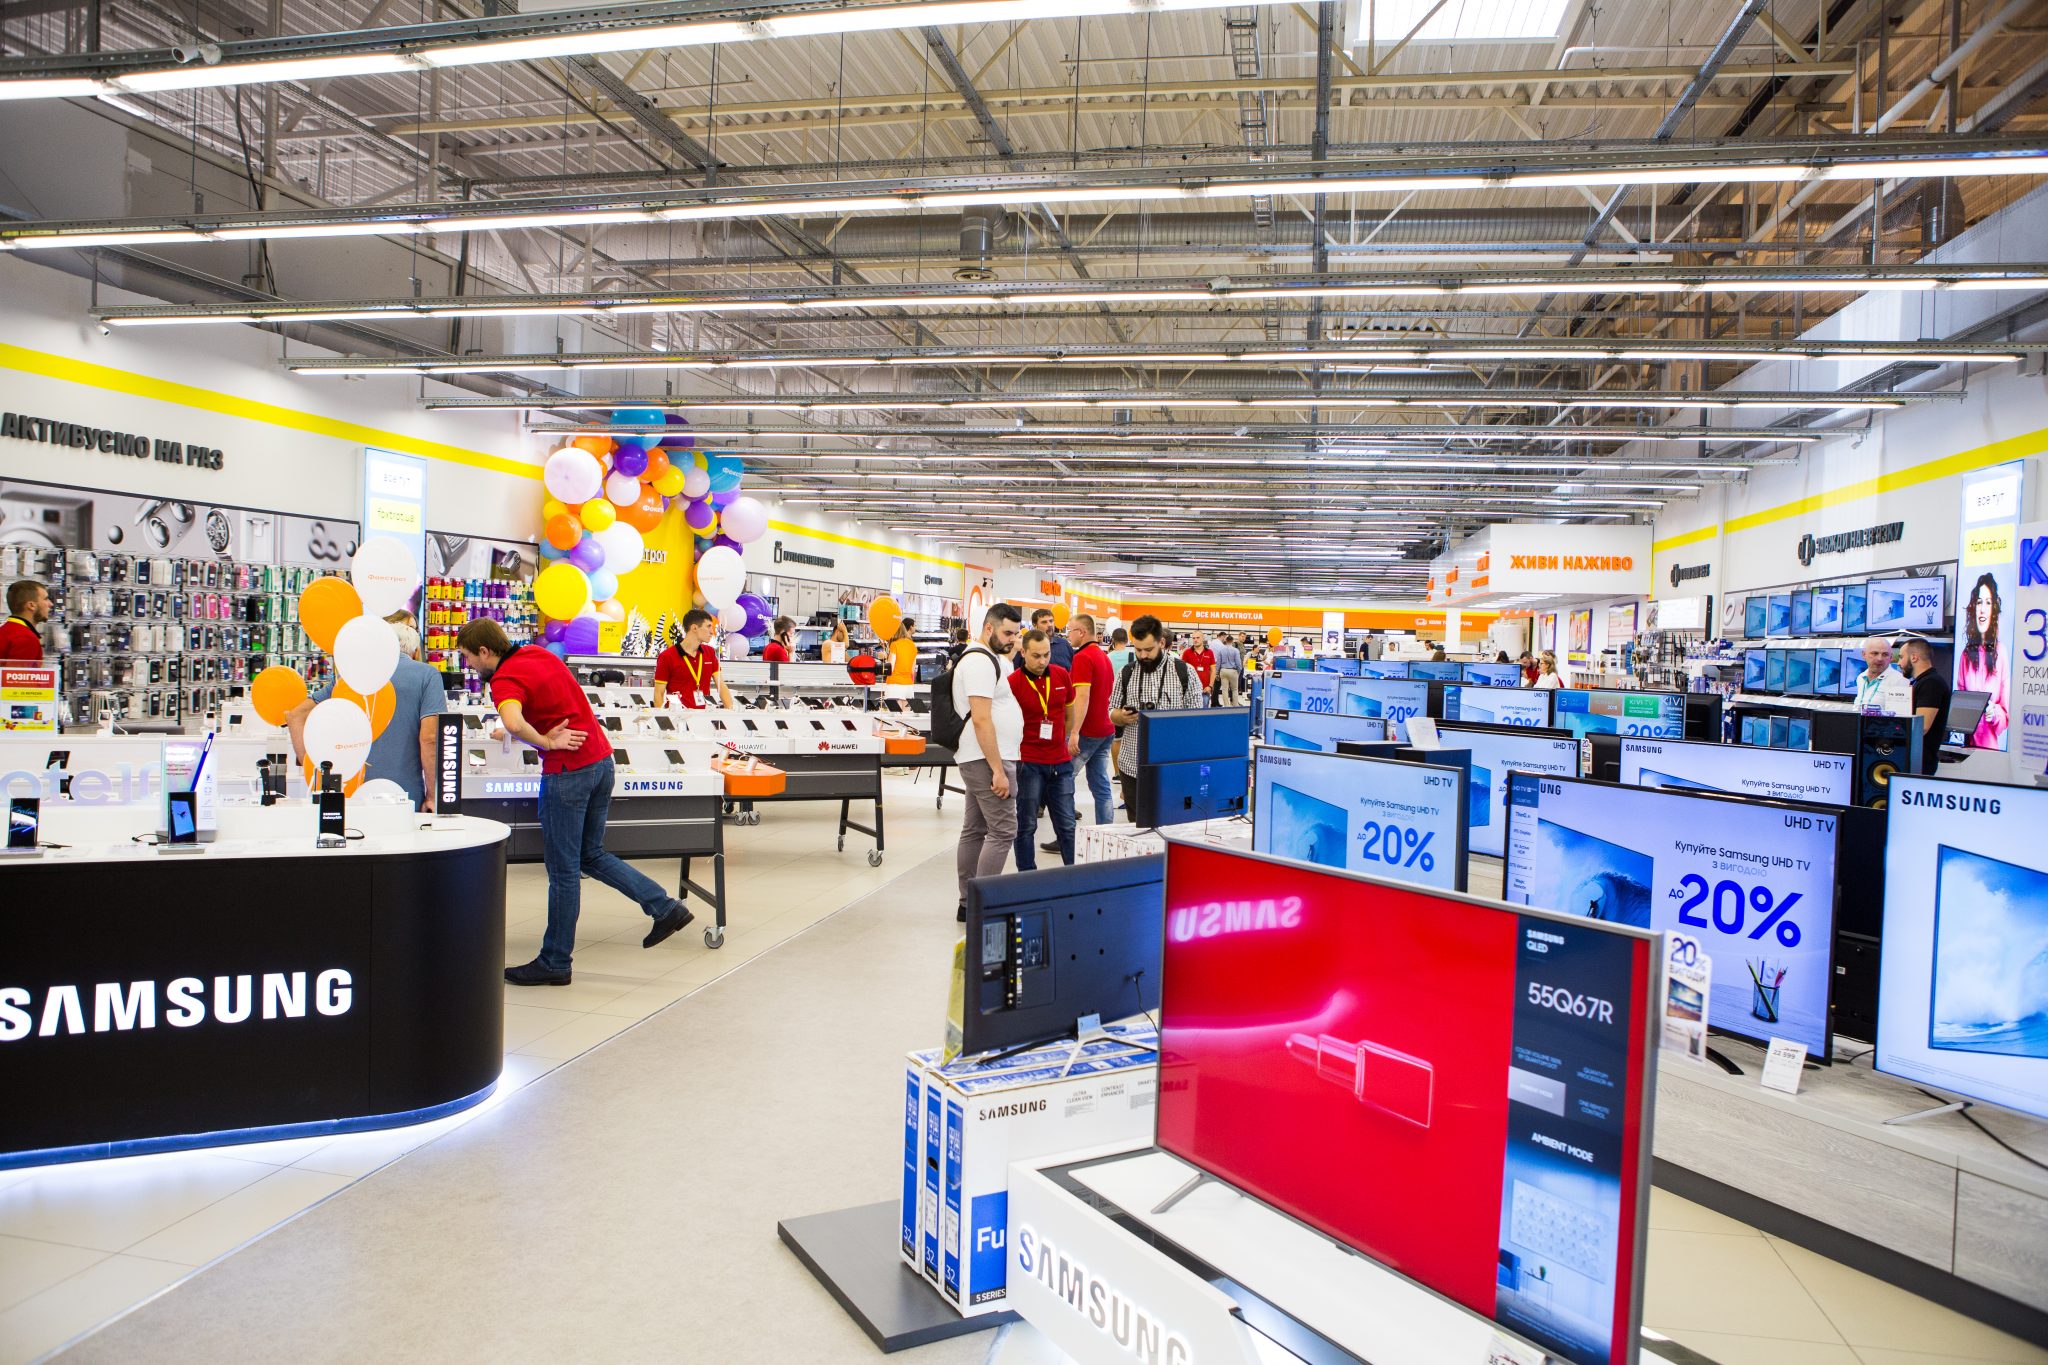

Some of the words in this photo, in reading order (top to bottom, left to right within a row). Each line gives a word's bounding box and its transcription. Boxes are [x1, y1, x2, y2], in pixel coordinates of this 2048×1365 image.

[1, 412, 150, 458] АКТИВУЄМО
[154, 438, 183, 464] НА
[187, 444, 224, 470] РАЗ
[1815, 532, 1848, 554] ЗАВЖДИ
[1510, 555, 1558, 570] ЖИВИ
[1562, 556, 1633, 571] НАЖИВО
[1909, 594, 1938, 609] 20%
[1221, 612, 1263, 620] FOXTROT.UA
[2022, 608, 2047, 661] 3
[6, 673, 50, 681] РОЗІГРАШ
[2022, 665, 2048, 679] РОКИ
[2022, 682, 2048, 696] ГАРА
[2022, 712, 2045, 727] KIVI
[1553, 742, 1566, 750] UHD
[1568, 743, 1578, 752] TV
[1625, 744, 1662, 755] SAMSUNG
[443, 725, 458, 803] SAMSUNG
[1260, 754, 1292, 767] SAMSUNG
[1814, 760, 1832, 769] UHD
[1834, 762, 1846, 770] TV
[486, 782, 540, 793] SAMSUN
[624, 781, 683, 791] SAMSUNG
[1424, 776, 1440, 786] UHD
[1442, 778, 1452, 788] TV
[1741, 779, 1770, 790] Купуйте
[1771, 782, 1804, 793] Samsung
[1806, 784, 1820, 794] UHD
[1820, 786, 1831, 794] TV
[1360, 797, 1386, 810] Купуйте
[1386, 800, 1416, 815] Samsung
[1416, 805, 1430, 815] UHD
[1430, 808, 1440, 816] TV
[1902, 790, 2001, 815] SAMSUNG
[1784, 815, 1812, 830] UHD
[1816, 819, 1834, 833] TV
[1363, 821, 1436, 872] 20%
[1675, 840, 1717, 858] Купуйте
[1718, 848, 1769, 867] Samsung
[1772, 856, 1793, 868] UHD
[1796, 860, 1810, 871] TV
[1679, 873, 1804, 948] 20%
[1526, 929, 1564, 945] SAMSUNG
[1526, 940, 1548, 954] QLED
[1671, 937, 1706, 972] 20%
[0, 968, 353, 1042] SAMSUNG
[1528, 982, 1614, 1025] 55Q67R
[979, 1100, 1047, 1121] SAMSUNG
[1531, 1132, 1568, 1152] AMBIENT
[1568, 1144, 1594, 1162] MODE
[977, 1226, 1007, 1252] Fu
[946, 1264, 956, 1285] 32
[976, 1294, 981, 1302] 5
[982, 1288, 1006, 1301] SERIES
[1019, 1227, 1188, 1365] SAMSUNG
